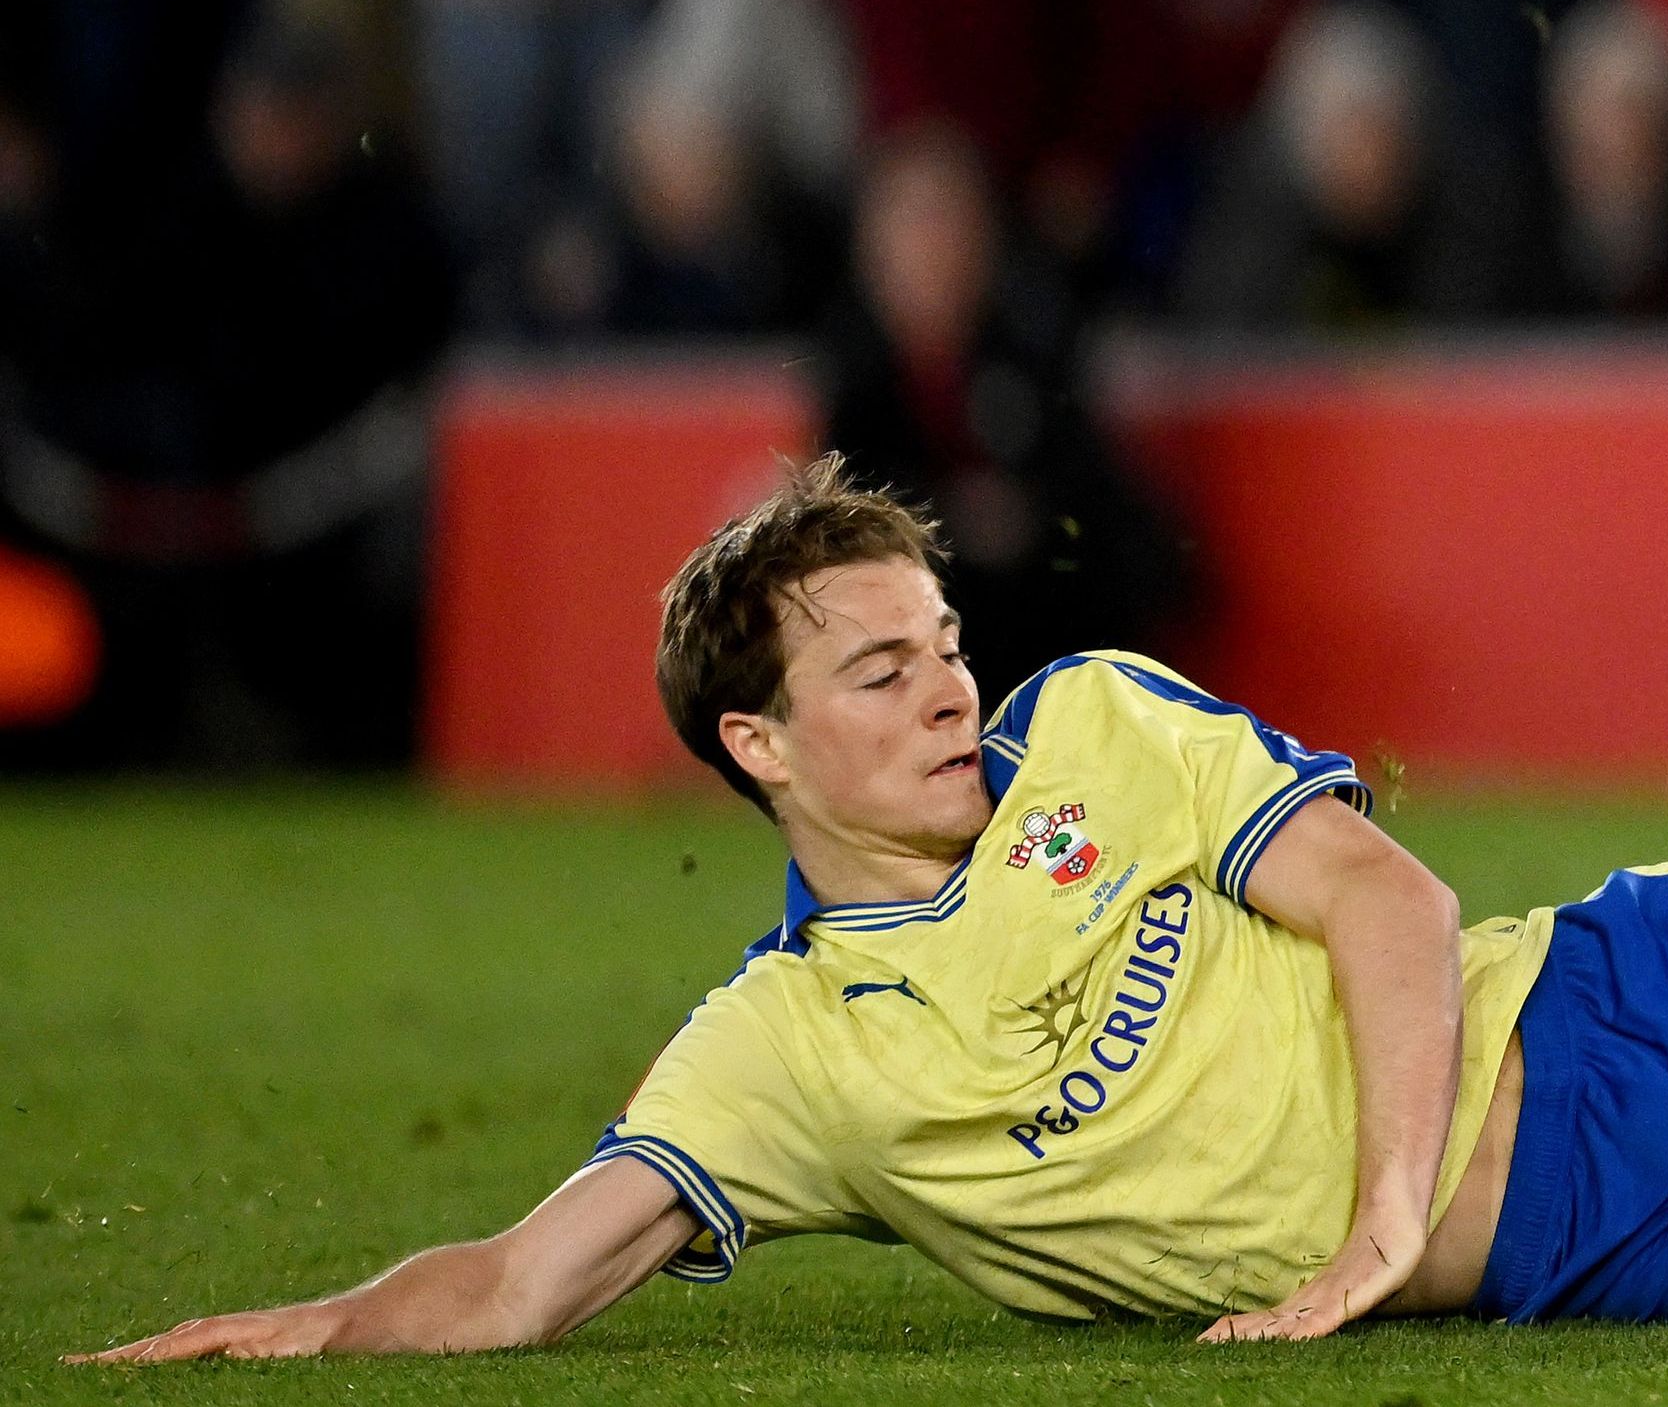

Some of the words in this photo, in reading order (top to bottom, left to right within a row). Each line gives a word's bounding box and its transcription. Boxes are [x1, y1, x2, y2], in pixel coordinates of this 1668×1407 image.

[1089, 879, 1112, 903] 1976
[1075, 922, 1090, 937] FA
[1088, 902, 1105, 923] CUP
[1006, 1071, 1106, 1160] P&O
[1090, 882, 1193, 1073] CRUISES
